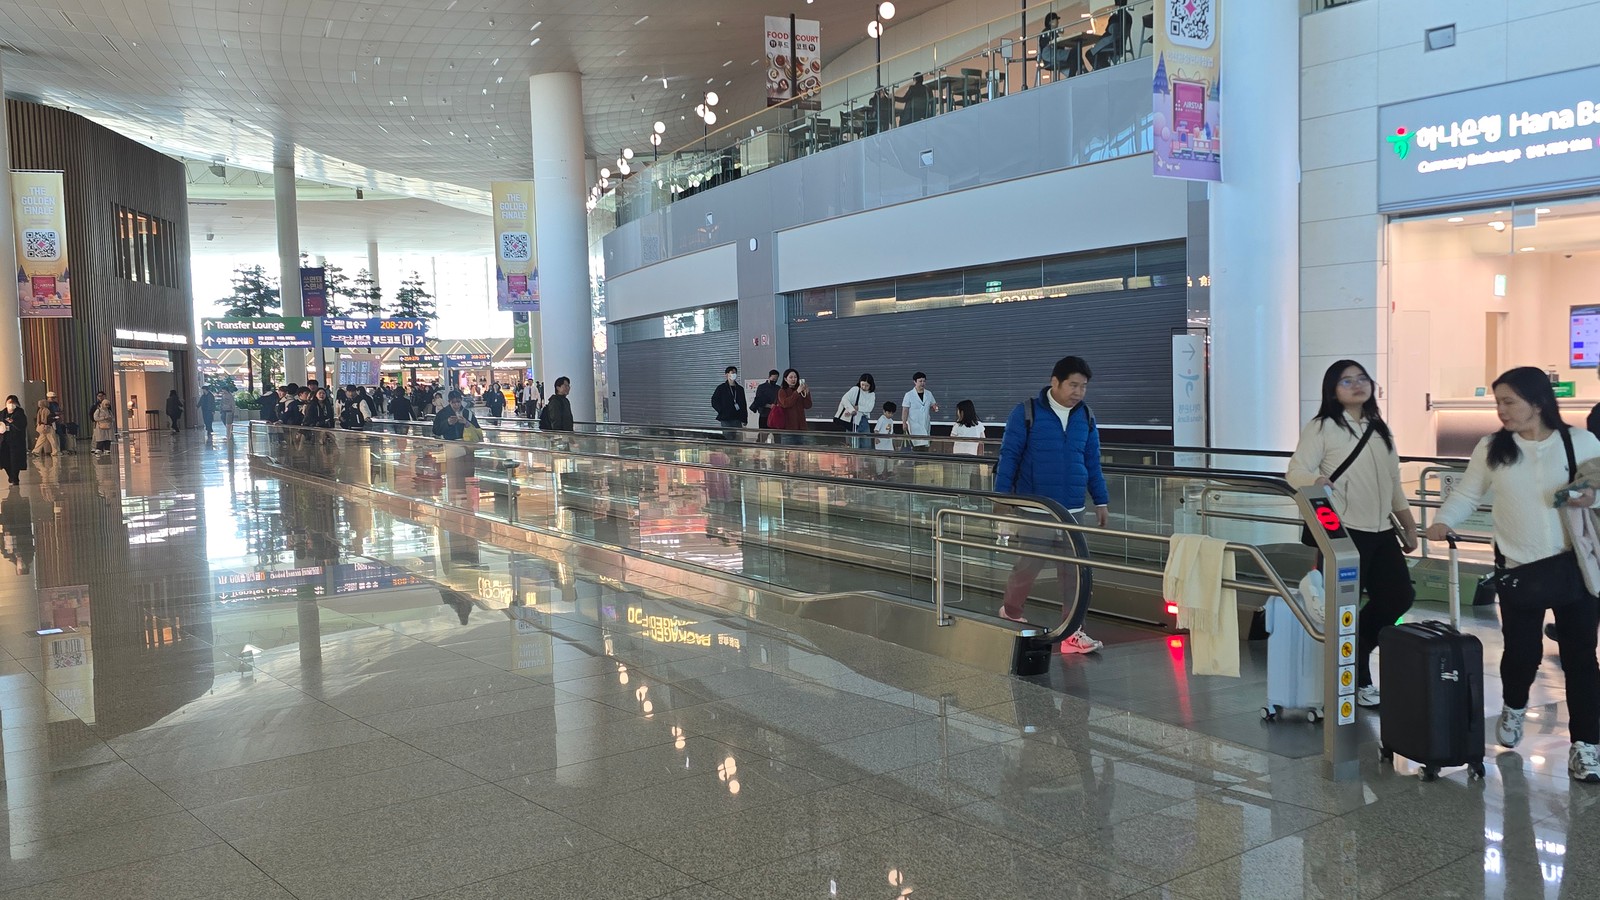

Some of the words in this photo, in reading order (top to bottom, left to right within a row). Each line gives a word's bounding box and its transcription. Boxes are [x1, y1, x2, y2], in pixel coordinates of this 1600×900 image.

[767, 31, 789, 40] FOOD
[796, 34, 818, 42] COURT
[1509, 108, 1575, 137] Hana
[1416, 114, 1501, 151] 하나은행
[29, 186, 46, 196] THE
[21, 196, 56, 206] GOLDEN
[506, 193, 521, 201] THE
[24, 206, 54, 216] FINALE
[500, 202, 528, 211] GOLDEN
[501, 211, 527, 220] FINALE
[215, 321, 251, 330] Transfer
[252, 321, 285, 331] Lounge
[301, 320, 312, 329] 4F
[380, 321, 413, 329] 208-270
[373, 335, 401, 344] 푸드코트
